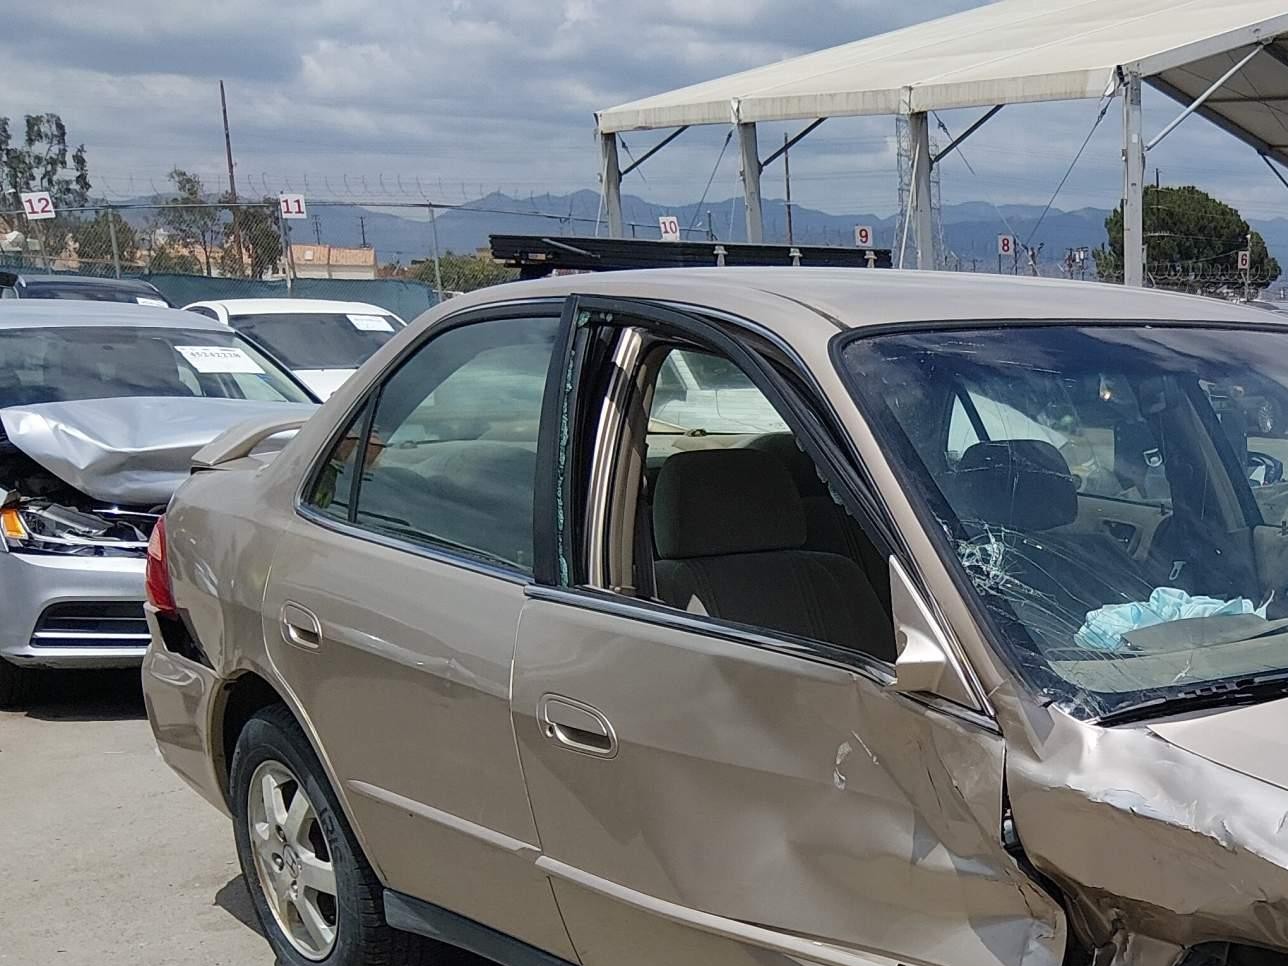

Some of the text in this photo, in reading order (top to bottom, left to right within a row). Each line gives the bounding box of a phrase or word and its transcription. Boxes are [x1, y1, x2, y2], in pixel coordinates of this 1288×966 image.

[24, 197, 52, 214] 12
[281, 199, 304, 214] 11
[661, 220, 677, 234] 10
[859, 228, 868, 244] 9
[1002, 238, 1010, 252] 8
[1240, 253, 1248, 266] 6
